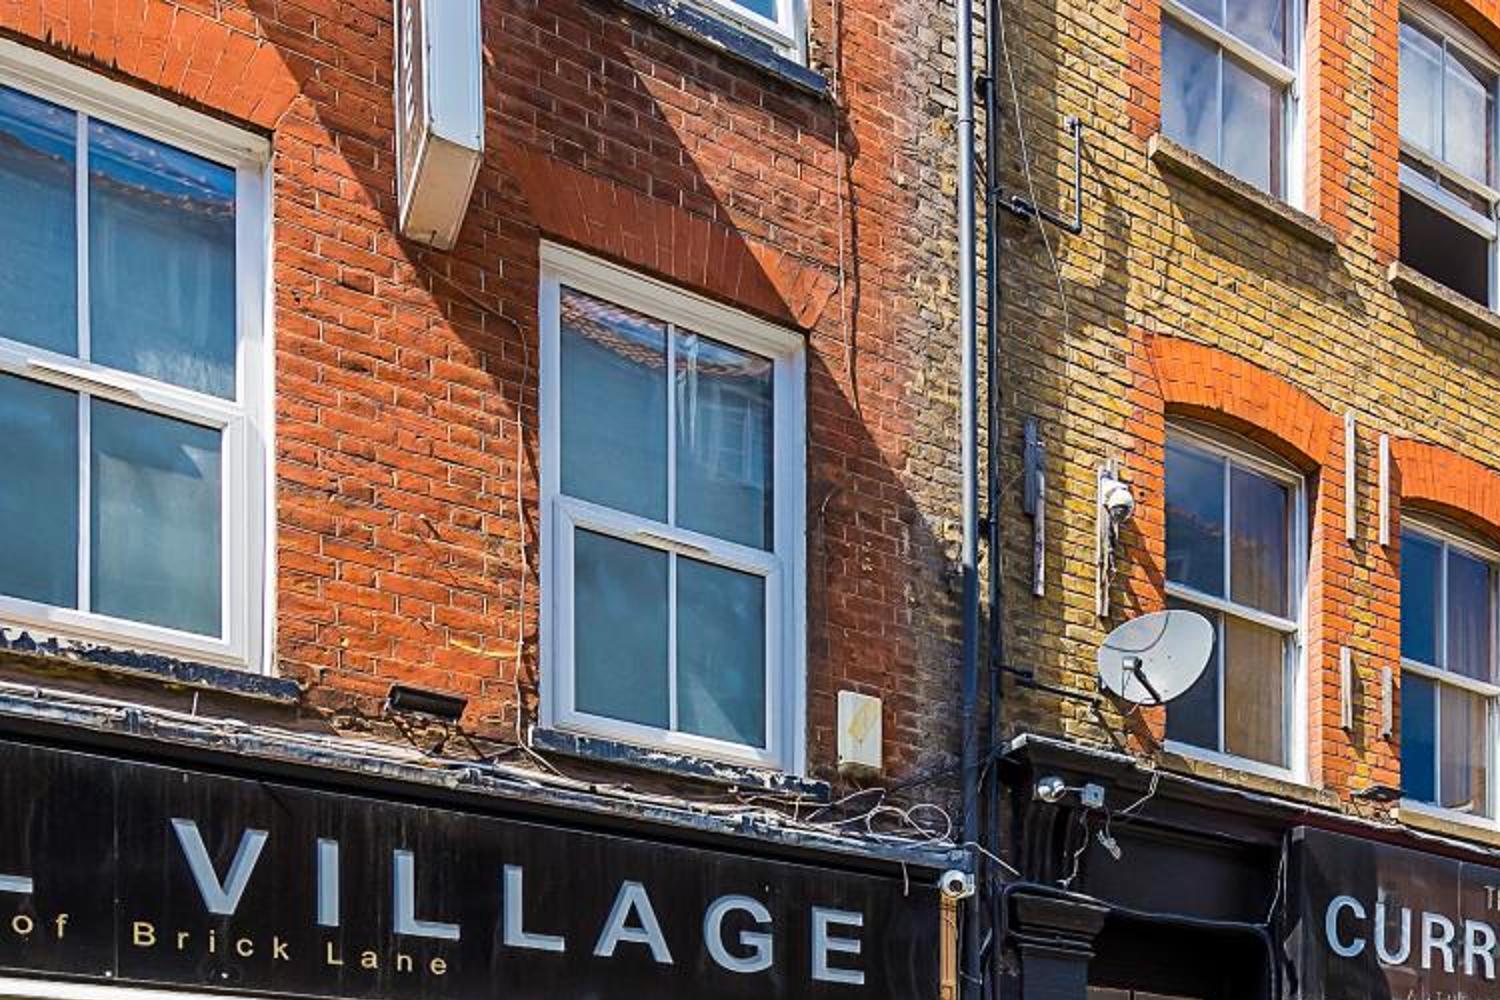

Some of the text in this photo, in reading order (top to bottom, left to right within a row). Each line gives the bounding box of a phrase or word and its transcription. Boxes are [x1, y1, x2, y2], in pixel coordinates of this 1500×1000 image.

[12, 913, 447, 975] of Brick Lane
[170, 817, 865, 985] VILLAGE
